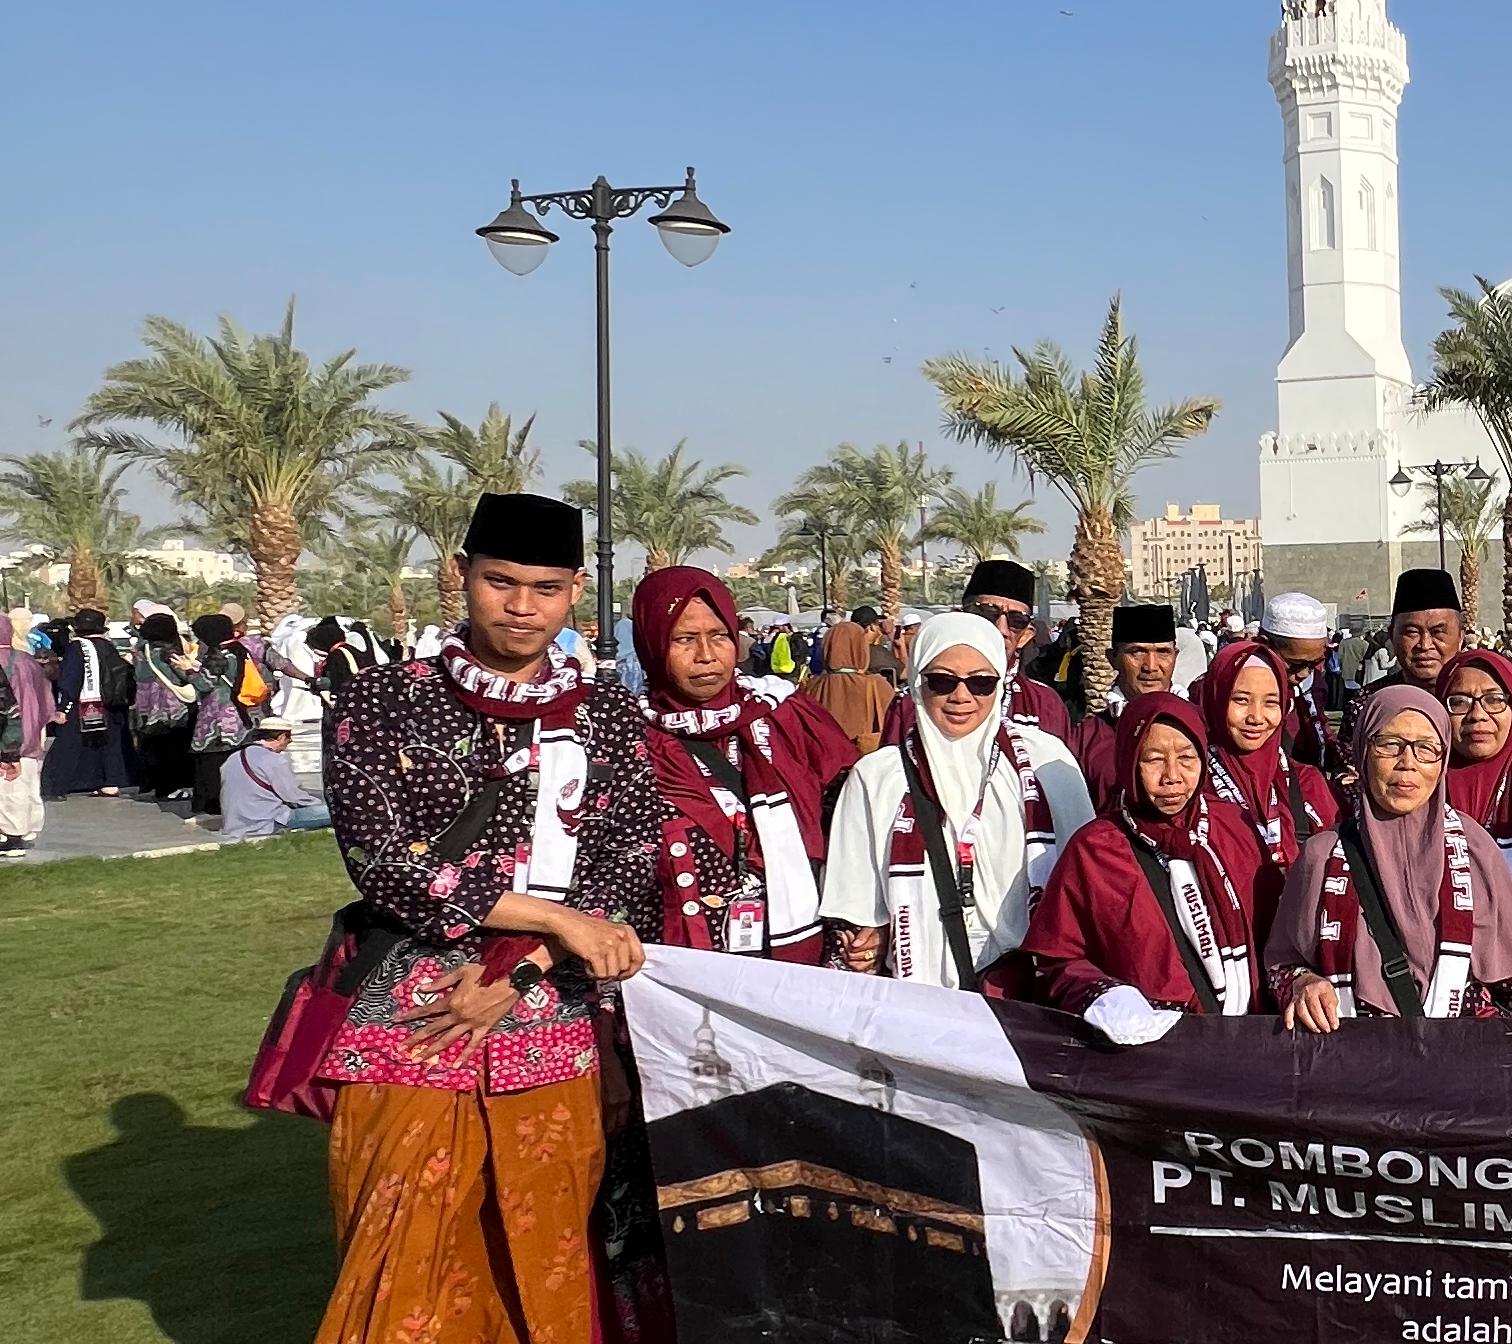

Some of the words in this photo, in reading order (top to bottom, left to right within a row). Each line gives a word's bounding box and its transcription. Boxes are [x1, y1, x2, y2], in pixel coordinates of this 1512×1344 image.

[1181, 883, 1214, 959] MUSLIMAH
[1150, 1160, 1246, 1208] PT.
[1281, 1262, 1433, 1302] Melayani
